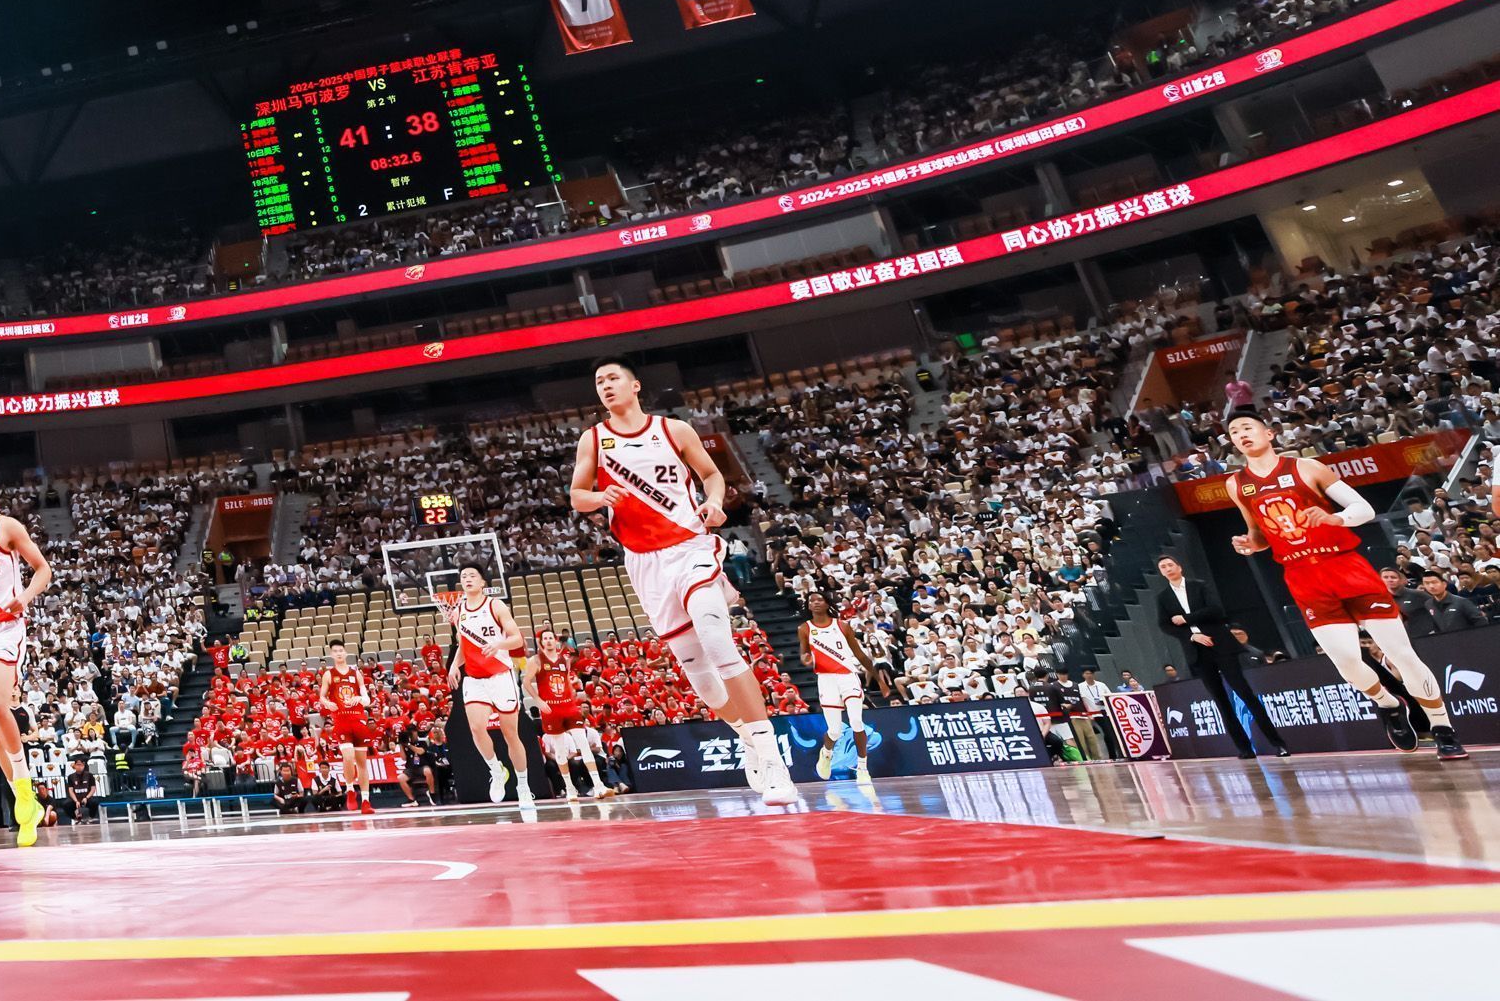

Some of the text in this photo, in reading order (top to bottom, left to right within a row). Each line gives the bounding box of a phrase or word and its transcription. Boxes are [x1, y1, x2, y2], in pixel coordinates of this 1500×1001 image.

[255, 84, 350, 117] 深圳马可波罗
[367, 77, 387, 92] VS
[412, 53, 499, 84] 江苏肯帝亚
[339, 125, 369, 149] 41
[405, 111, 440, 136] 38
[370, 151, 423, 171] 08:32.6
[358, 204, 369, 217] 2
[386, 195, 427, 211] 累计犯规
[443, 187, 453, 201] F
[788, 183, 1195, 302] 爱国敬业奋发图强 同心协力振兴篮球
[605, 454, 678, 512] JIANGSU
[655, 465, 678, 484] 25
[425, 508, 447, 525] 22
[1278, 515, 1297, 533] 3
[481, 626, 496, 637] 26
[836, 641, 843, 650] 0
[1451, 698, 1498, 716] LI-NING
[918, 708, 1025, 738] 核芯聚能
[1129, 704, 1152, 741] 百岁山
[1170, 727, 1189, 738] LI-NING
[927, 736, 1037, 766] 制霸领空
[638, 759, 685, 771] LI-NING
